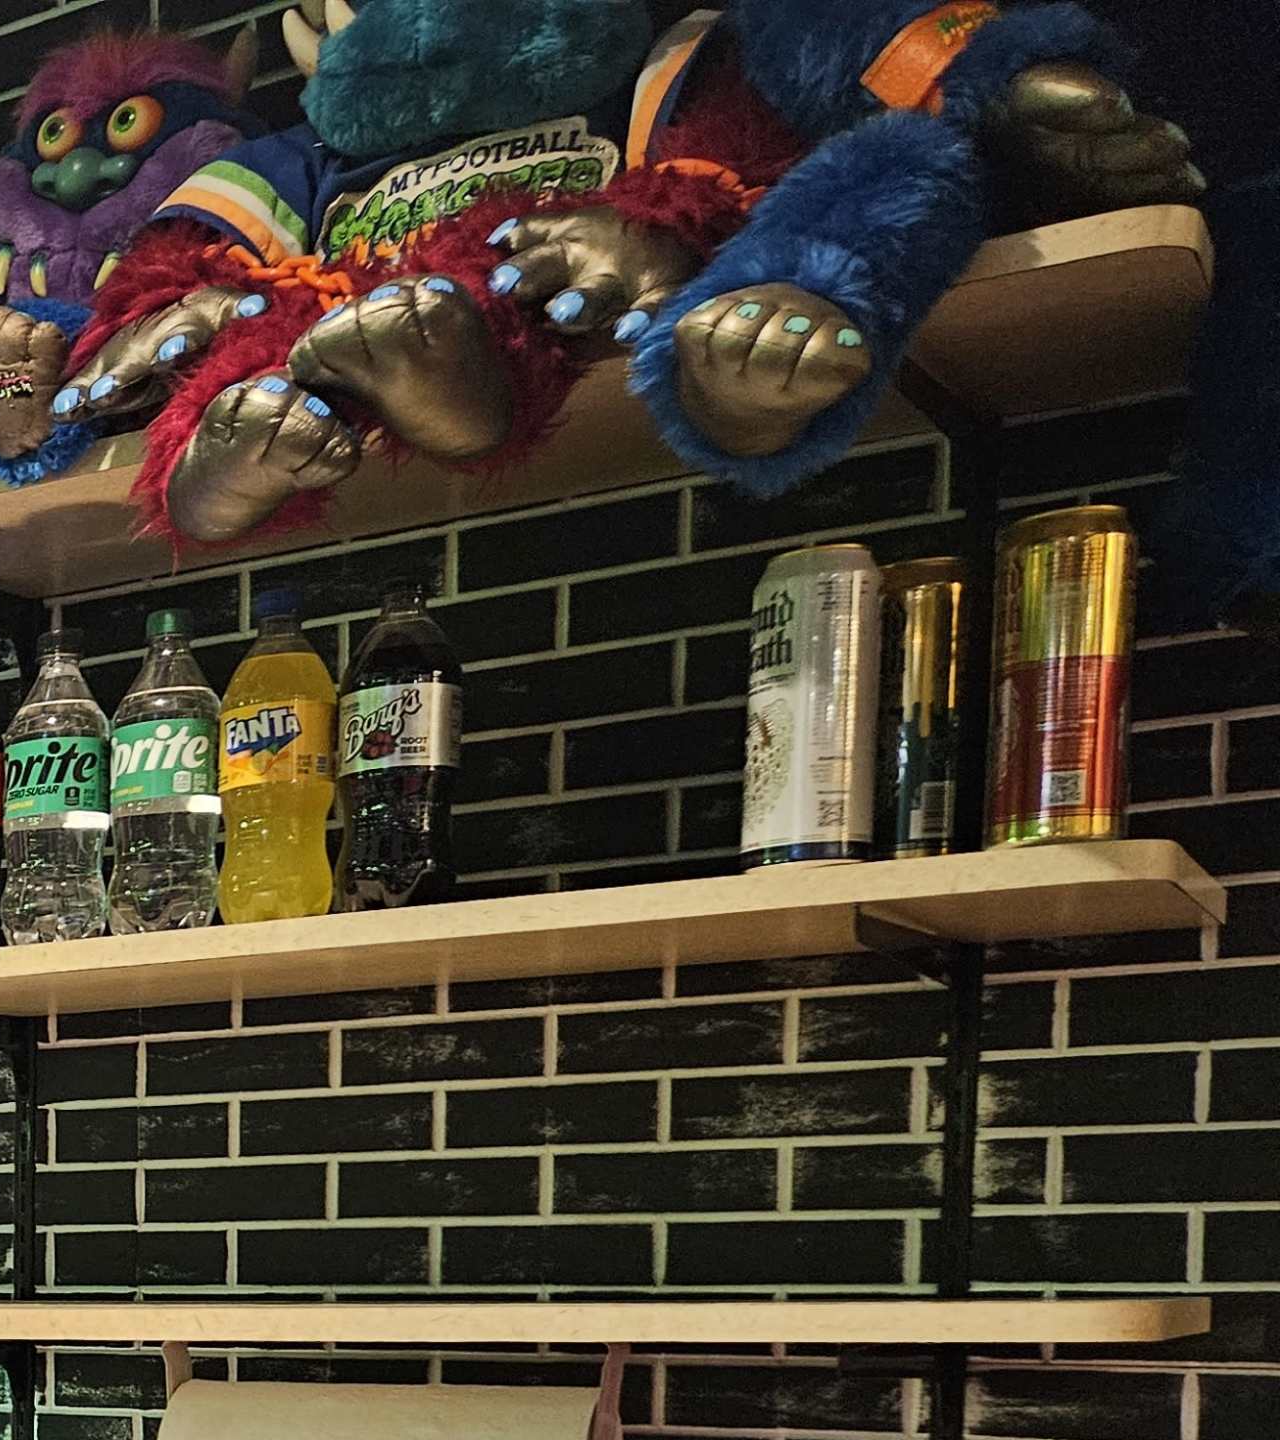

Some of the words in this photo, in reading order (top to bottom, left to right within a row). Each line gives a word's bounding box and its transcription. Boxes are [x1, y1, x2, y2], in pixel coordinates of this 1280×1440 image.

[388, 164, 427, 197] MY
[427, 129, 585, 181] FOOTBALL
[752, 589, 794, 631] uid
[752, 629, 792, 671] ath
[226, 706, 301, 748] FANTA
[342, 688, 422, 762] Barq's
[401, 736, 428, 747] ROOT
[5, 742, 97, 792] prite
[400, 745, 426, 755] BEER
[27, 784, 59, 797] SUGAR
